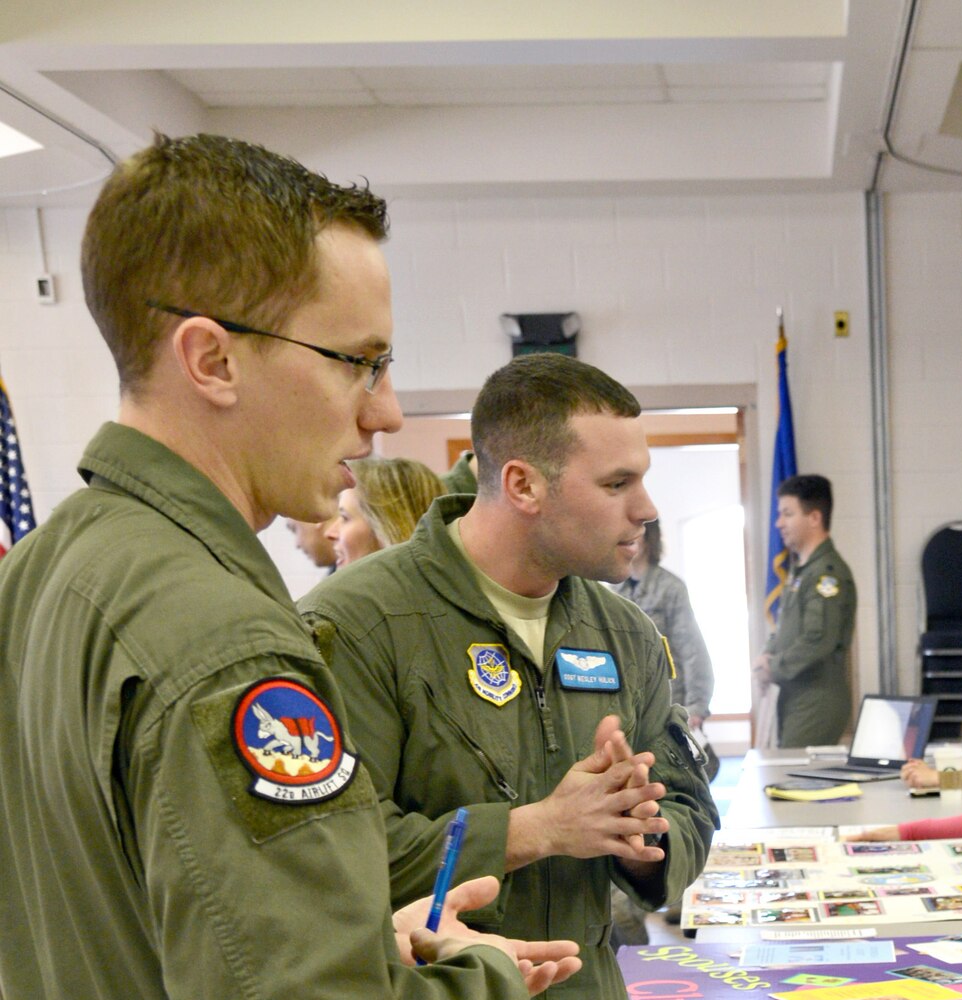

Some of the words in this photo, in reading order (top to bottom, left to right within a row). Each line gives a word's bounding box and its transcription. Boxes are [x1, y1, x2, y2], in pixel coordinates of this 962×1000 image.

[302, 780, 338, 799] AIRLIFT
[338, 769, 350, 781] SQ
[637, 946, 771, 990] Spouses
